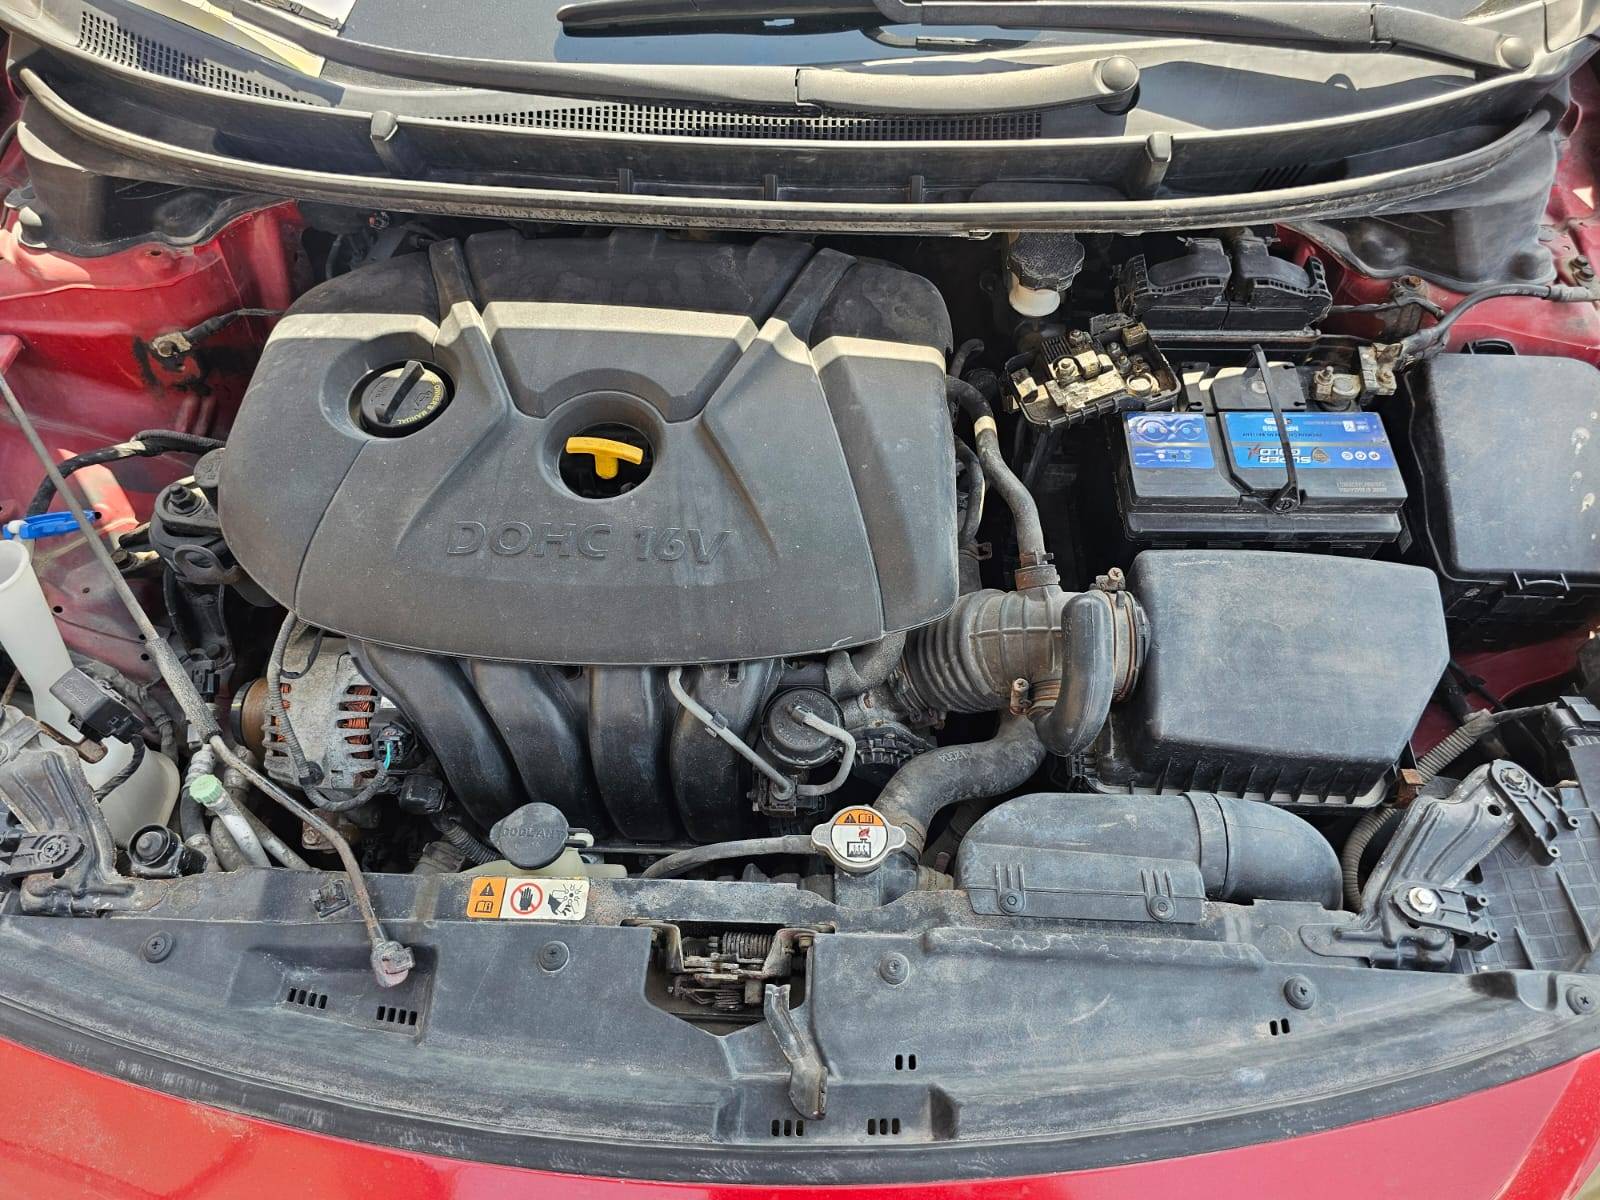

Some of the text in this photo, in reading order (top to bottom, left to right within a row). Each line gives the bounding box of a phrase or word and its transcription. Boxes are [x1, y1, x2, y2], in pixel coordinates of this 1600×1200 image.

[396, 409, 428, 425] MANUAL
[447, 520, 736, 565] DOHC 16V
